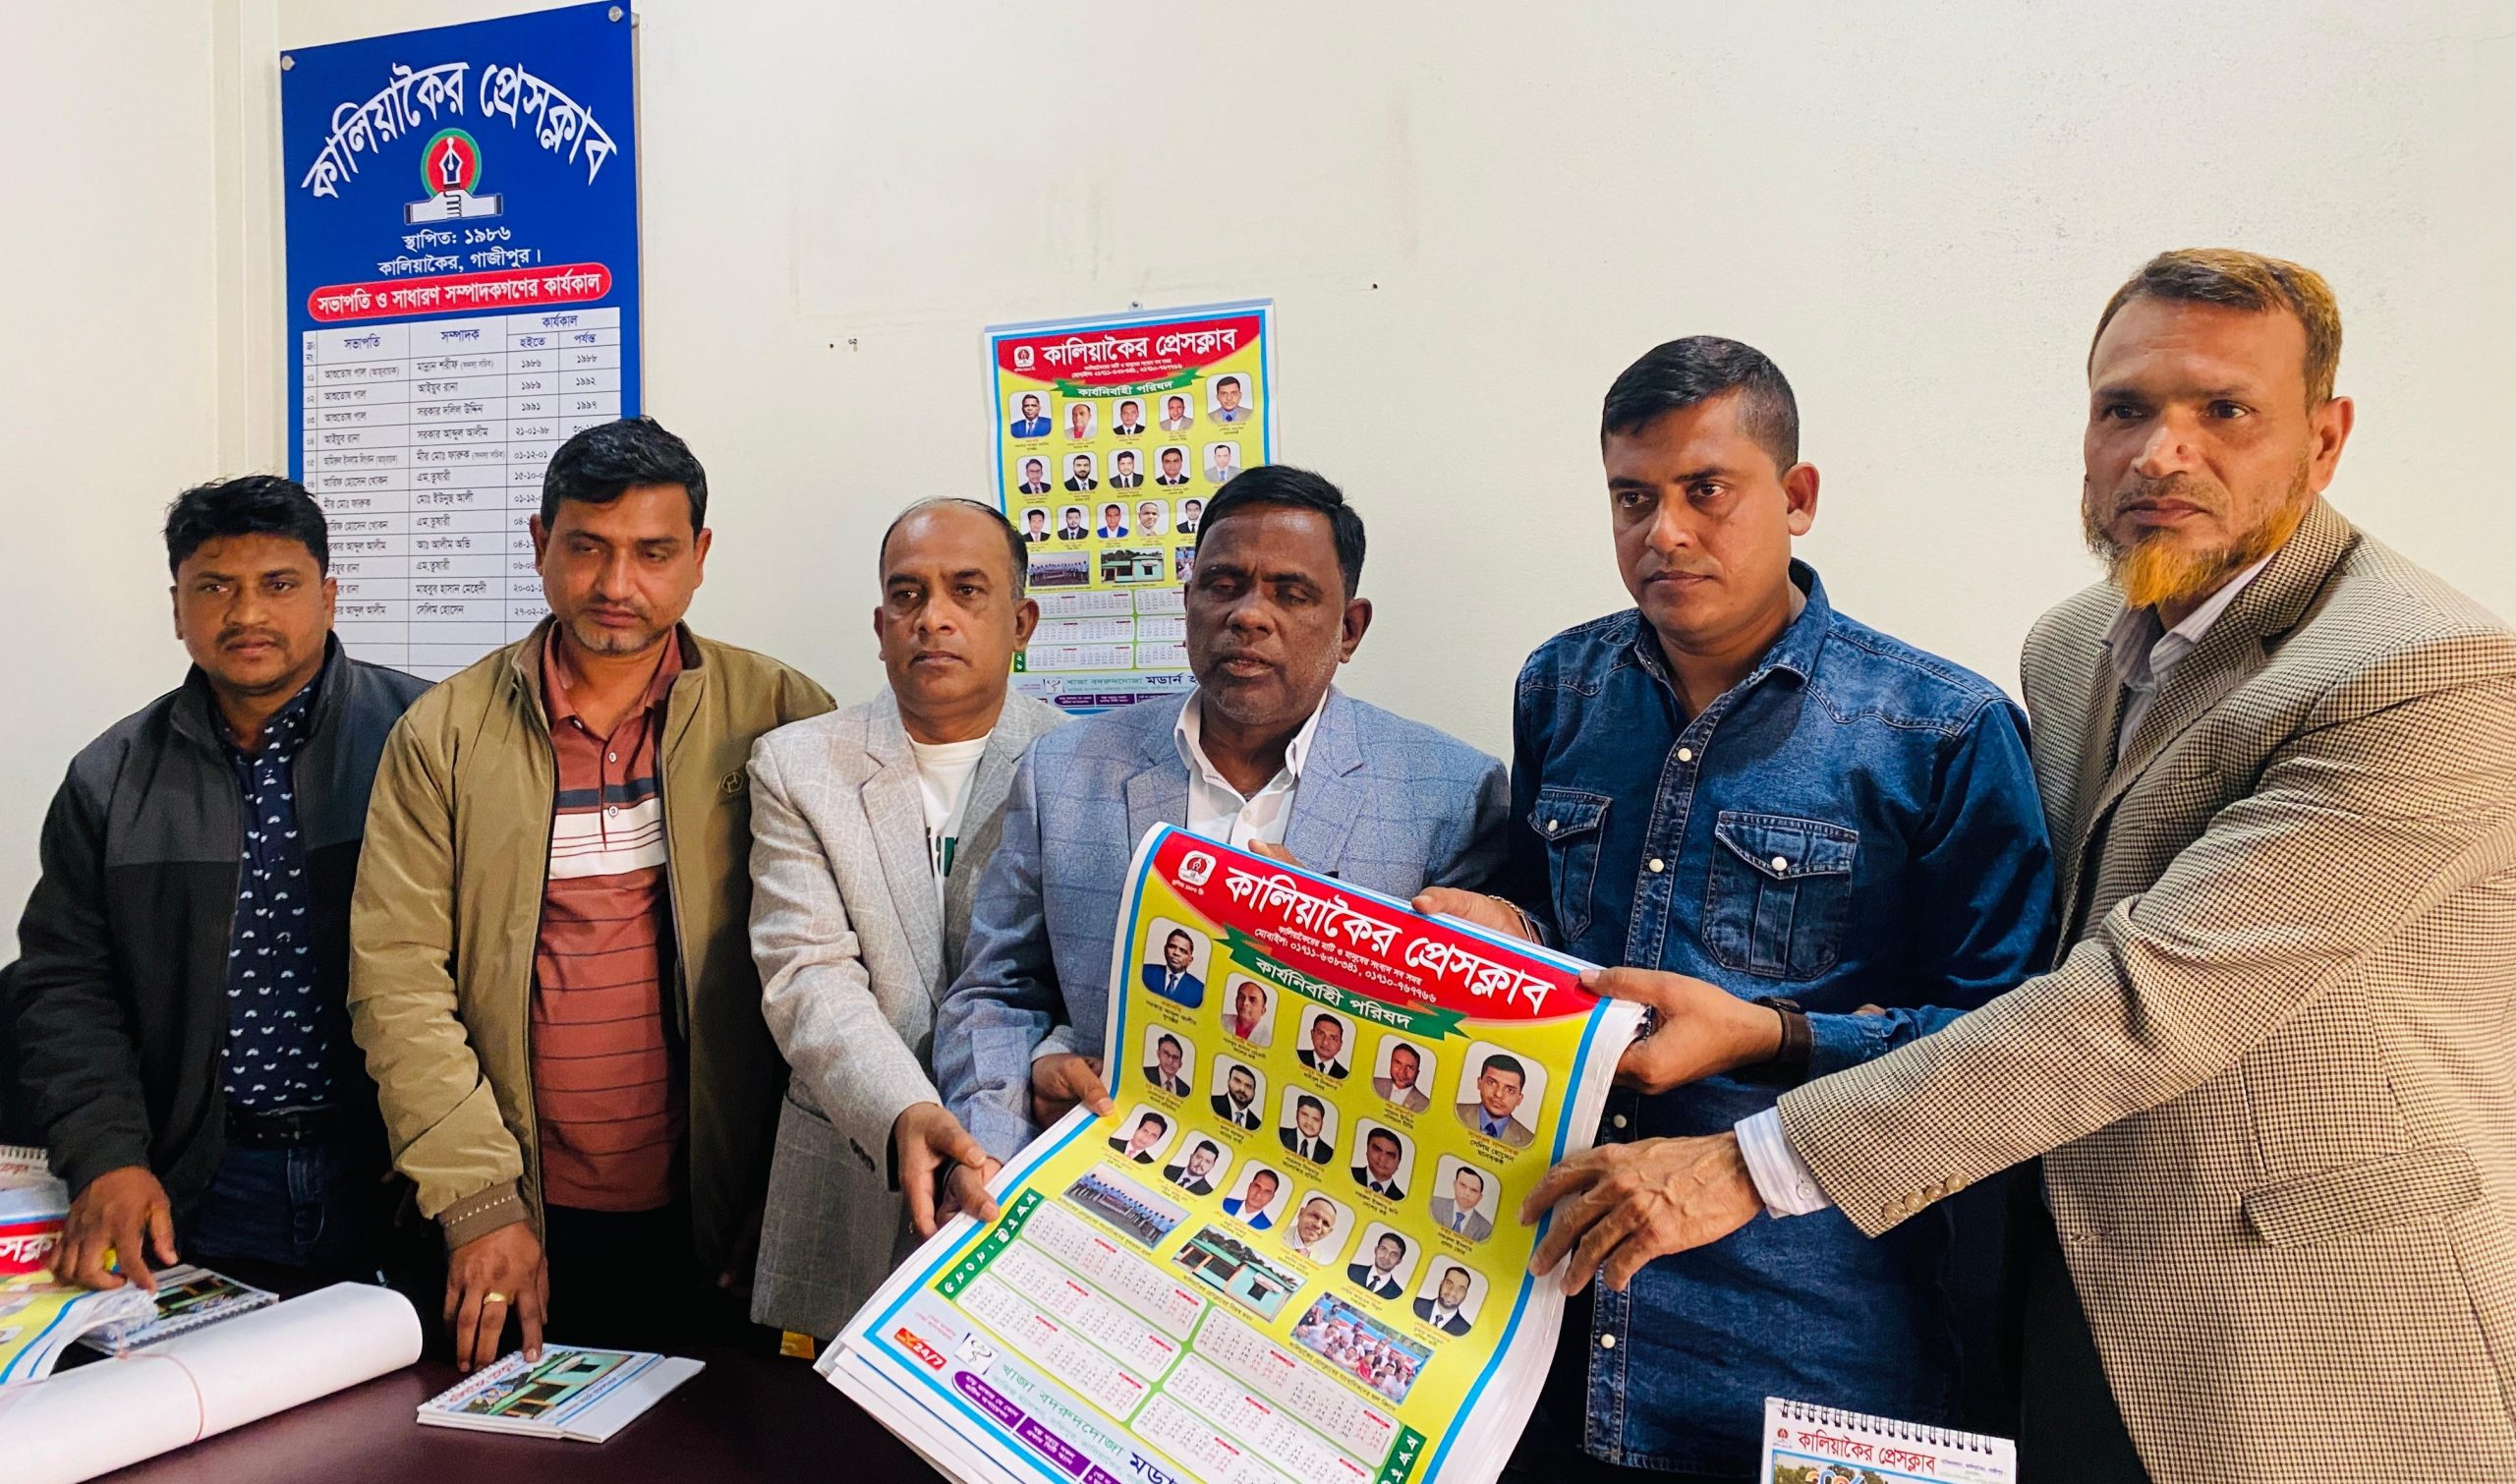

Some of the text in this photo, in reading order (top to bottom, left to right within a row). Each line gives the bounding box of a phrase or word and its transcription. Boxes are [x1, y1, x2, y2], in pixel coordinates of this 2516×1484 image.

[301, 62, 617, 199] কালিয়াকৈর প্রেসক্লাব
[464, 226, 511, 245] ১৯৮৬
[377, 255, 464, 276] কালিয়াকৈর,
[317, 271, 601, 315] সভাপতি ও সাধারণ সম্পাদকগণের কার্যকাল
[542, 313, 578, 328] কার্যকাল
[344, 333, 381, 350] সভাপতি
[440, 329, 481, 343] সম্পাদক
[519, 336, 546, 348] হইতে
[573, 331, 597, 344] পর্যন্ত
[1041, 328, 1238, 367] কালিয়াকৈর প্রেসক্লাব
[577, 355, 598, 364] ১৯৮৮
[576, 376, 597, 386] ১৯৯২
[1136, 380, 1174, 393] পরিষদ
[1145, 672, 1184, 685] মডার্ন
[1225, 865, 1556, 1015] কালিয়াকৈর প্রেসক্লাব
[1255, 956, 1413, 1030] কার্যনির্বাহী পরিষদ
[913, 1341, 946, 1369] 24/7
[1002, 1364, 1036, 1392] খাজা
[1798, 1429, 1874, 1461] কালিয়াকৈর
[1878, 1446, 1936, 1475] প্রেসক্লাব
